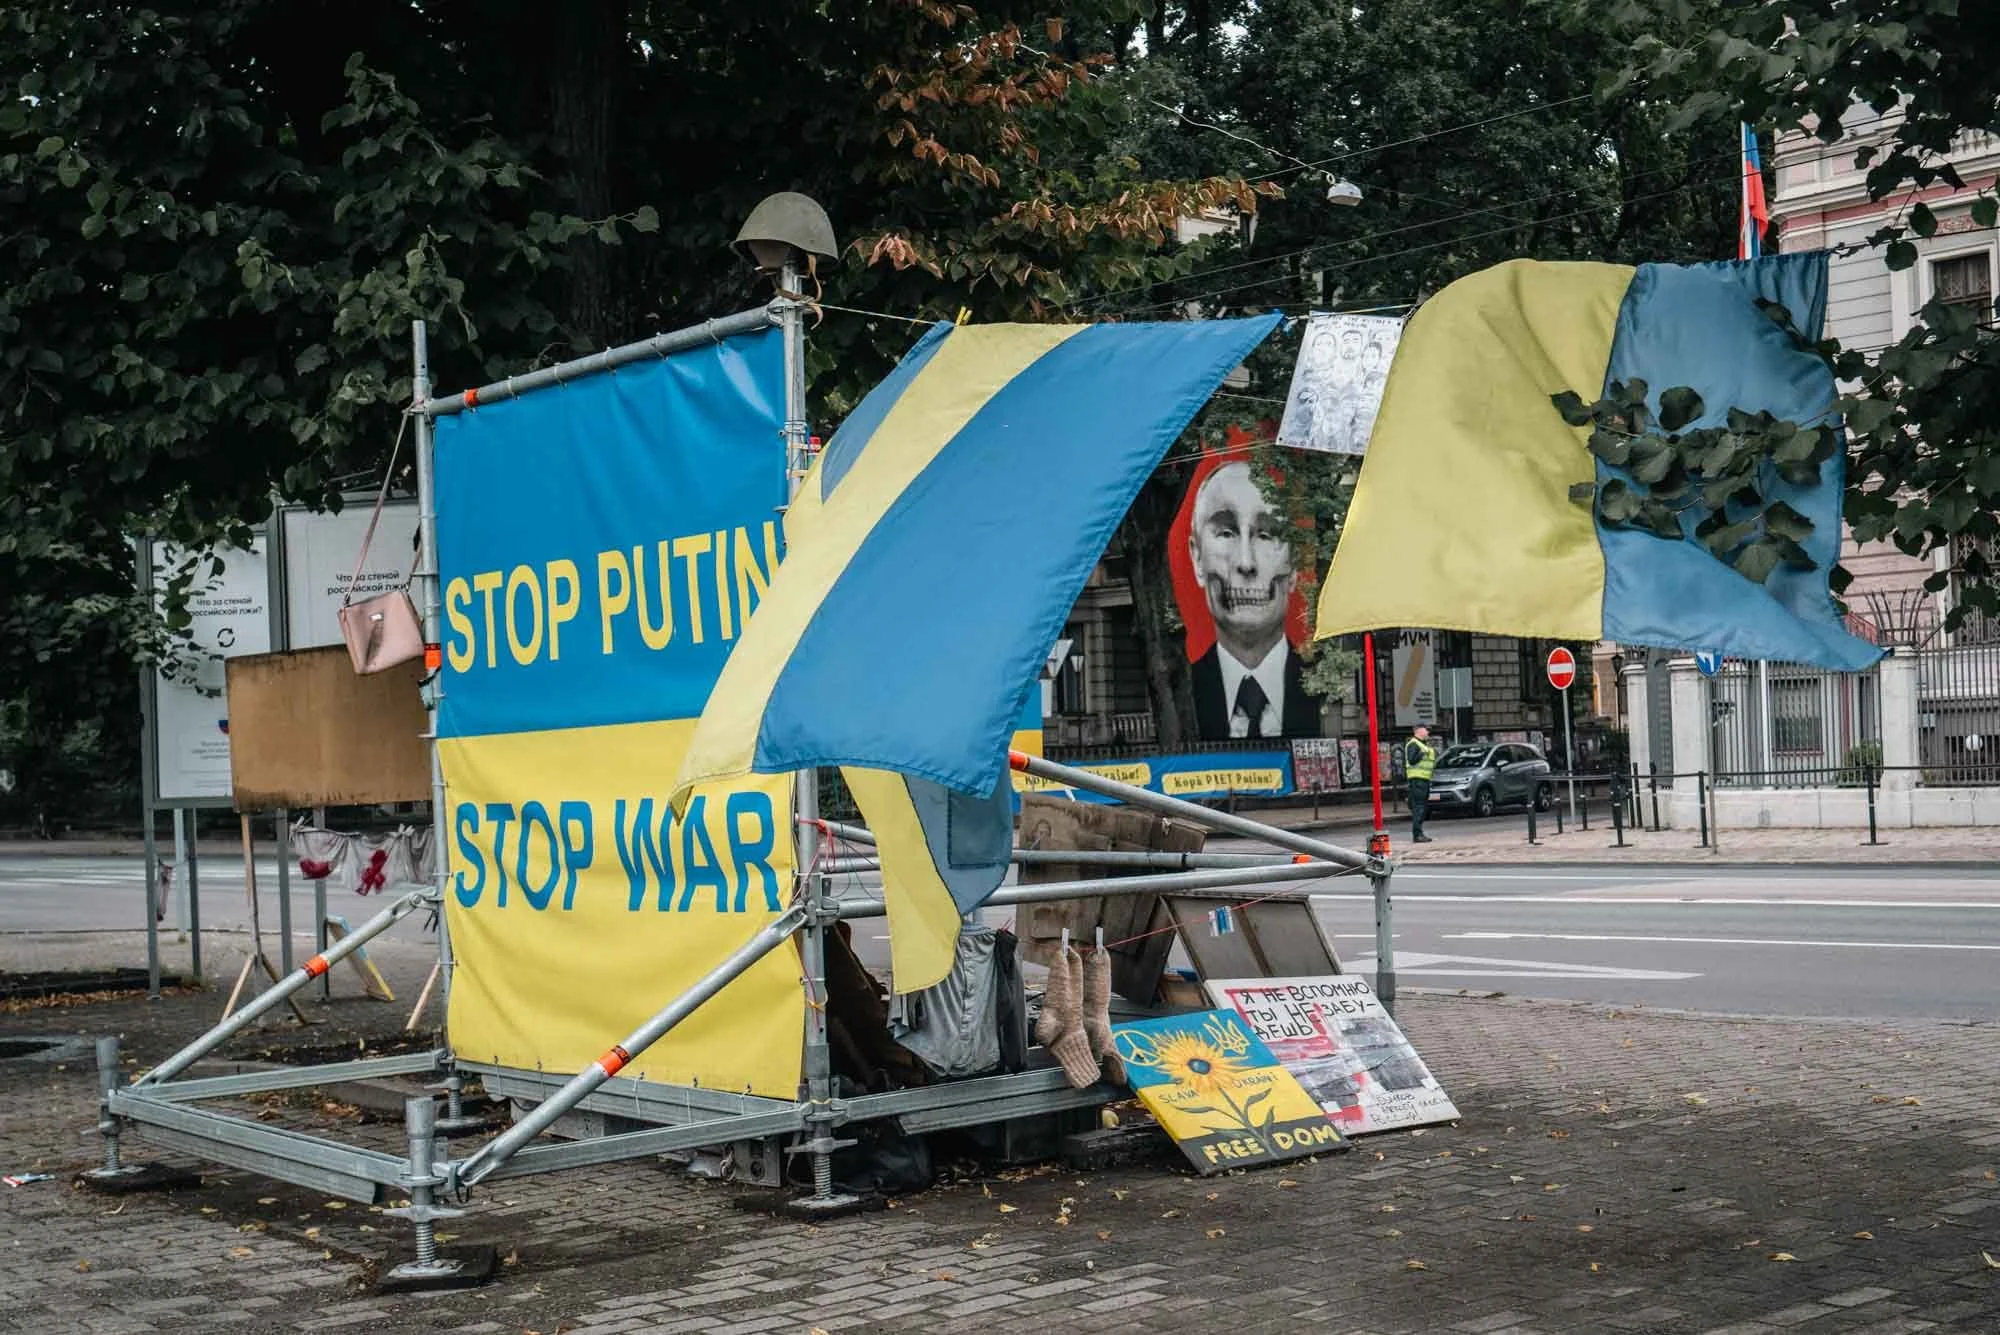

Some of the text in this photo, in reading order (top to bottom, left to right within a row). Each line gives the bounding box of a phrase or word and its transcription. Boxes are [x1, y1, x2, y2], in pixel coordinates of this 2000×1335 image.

[367, 569, 400, 581] стеной
[445, 520, 782, 674] STOP PUTIN
[1399, 630, 1430, 647] MVM
[454, 791, 783, 913] STOP WAR
[1240, 981, 1370, 1005] Я НЕ ВСПОМНЮ
[1245, 1008, 1278, 1023] ТЫ
[1283, 1002, 1321, 1026] НЕ
[1157, 1088, 1200, 1104] SLAVA
